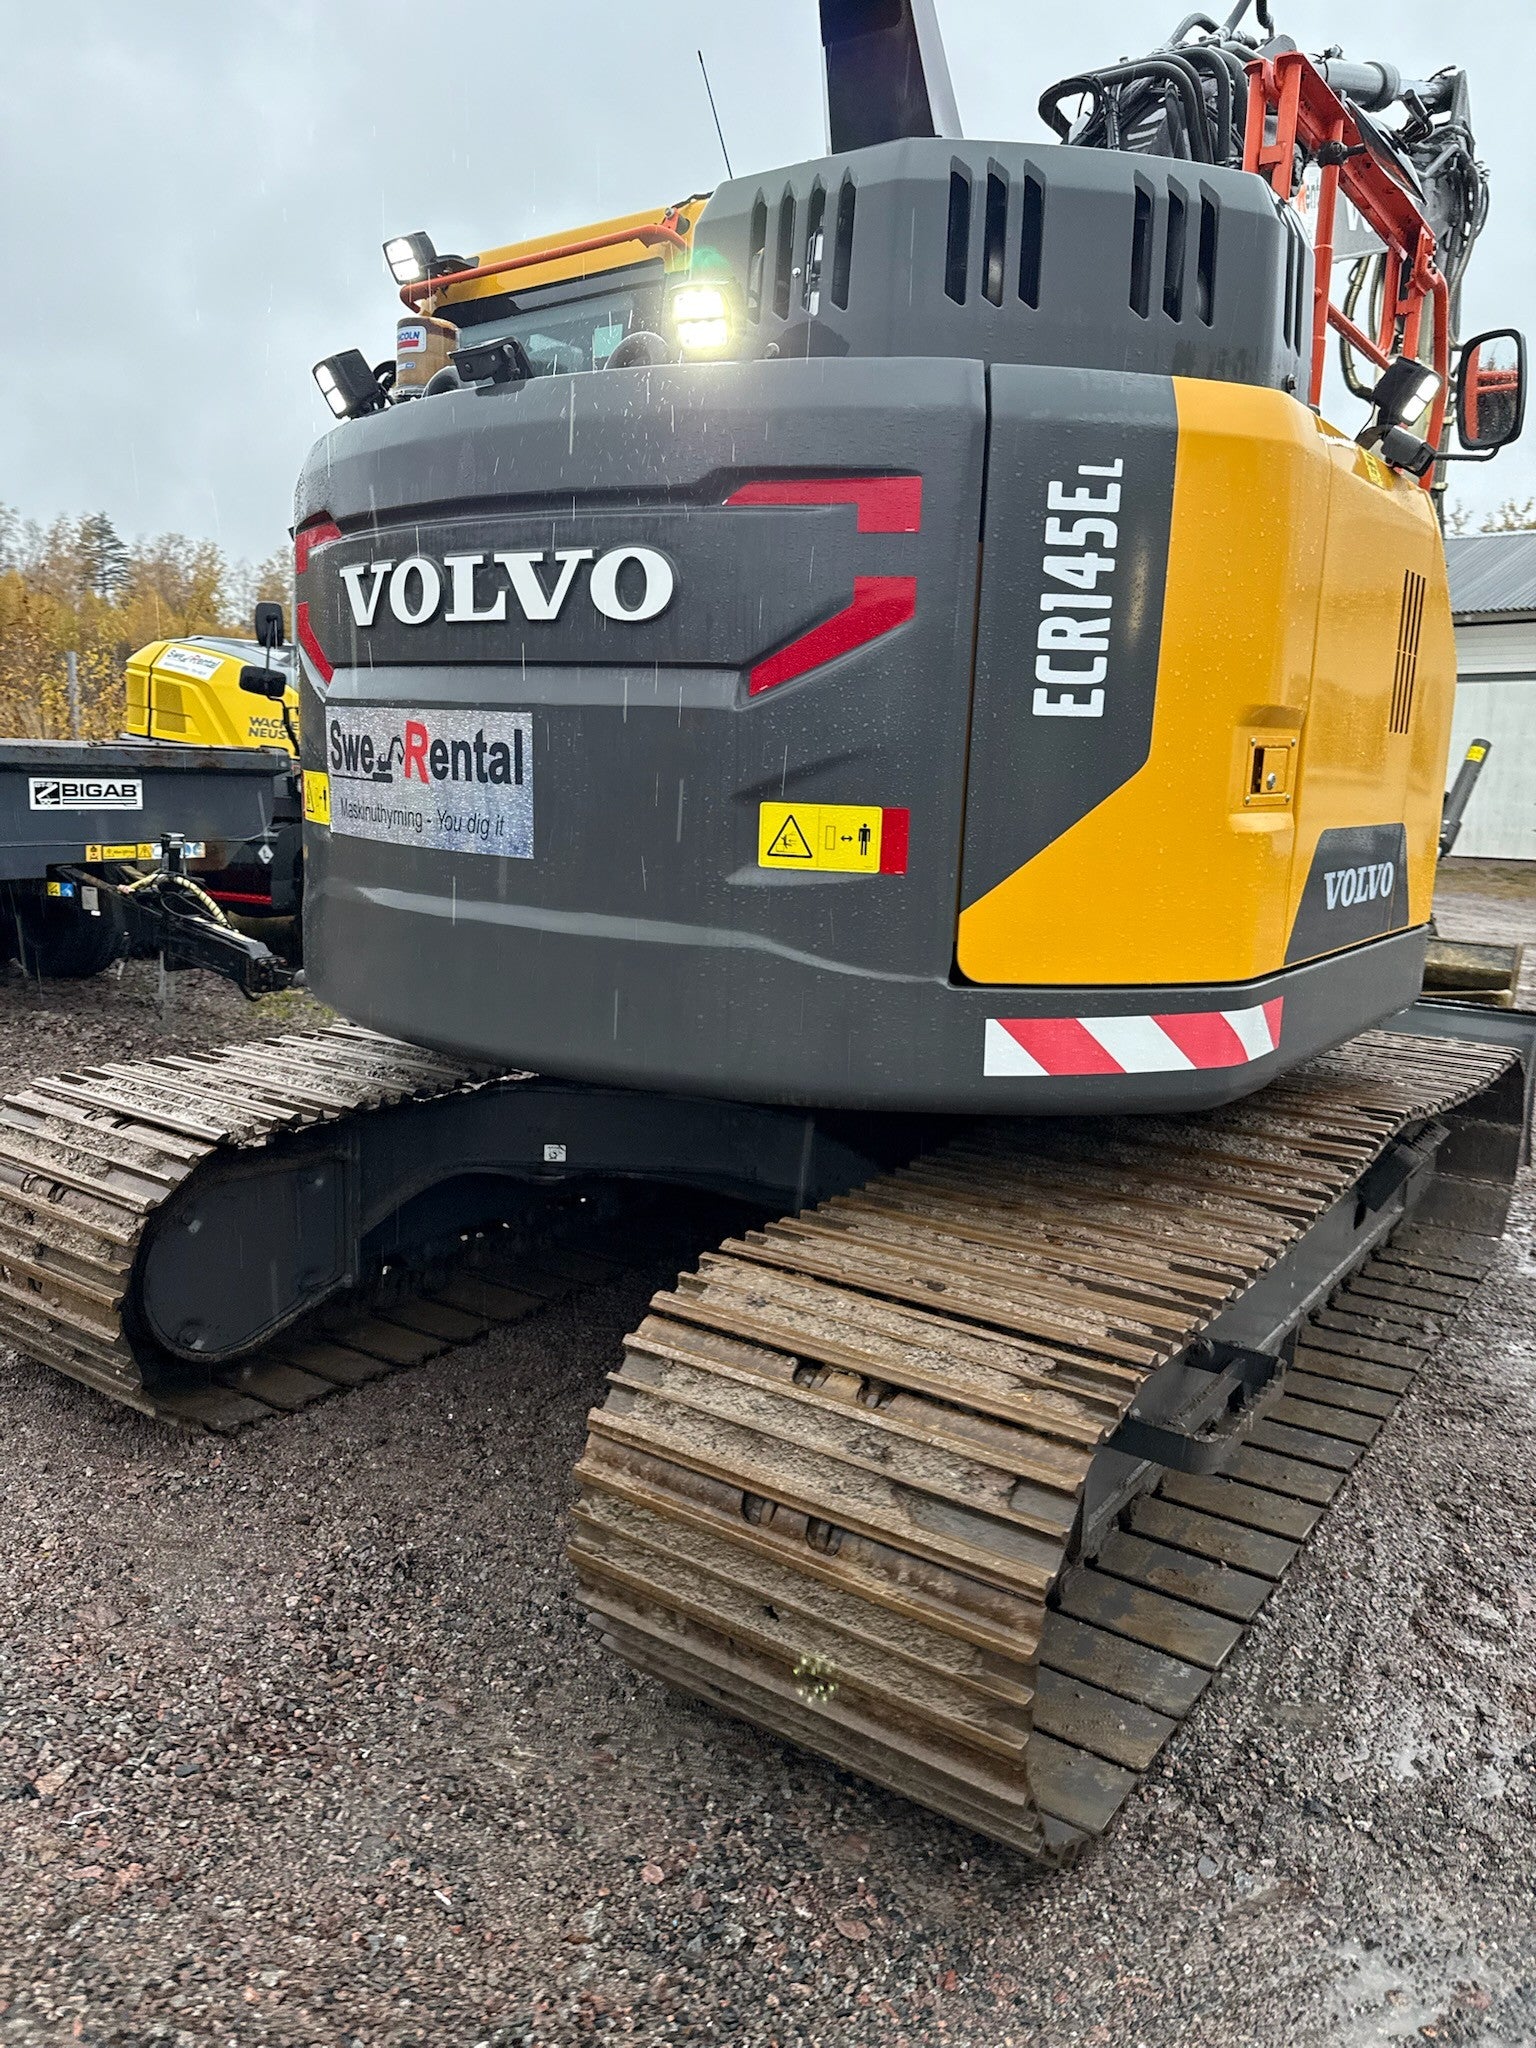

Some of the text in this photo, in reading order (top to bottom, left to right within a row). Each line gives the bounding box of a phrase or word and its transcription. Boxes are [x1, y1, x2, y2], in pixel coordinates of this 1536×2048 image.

[339, 547, 674, 627] VOLVO
[330, 719, 523, 785] Swe Rental
[62, 783, 137, 797] BIGAB
[340, 798, 423, 833] Maskinuthyrning
[436, 808, 462, 832] You
[467, 812, 490, 841] dig
[495, 814, 505, 836] it
[1323, 861, 1394, 911] VOLVO
